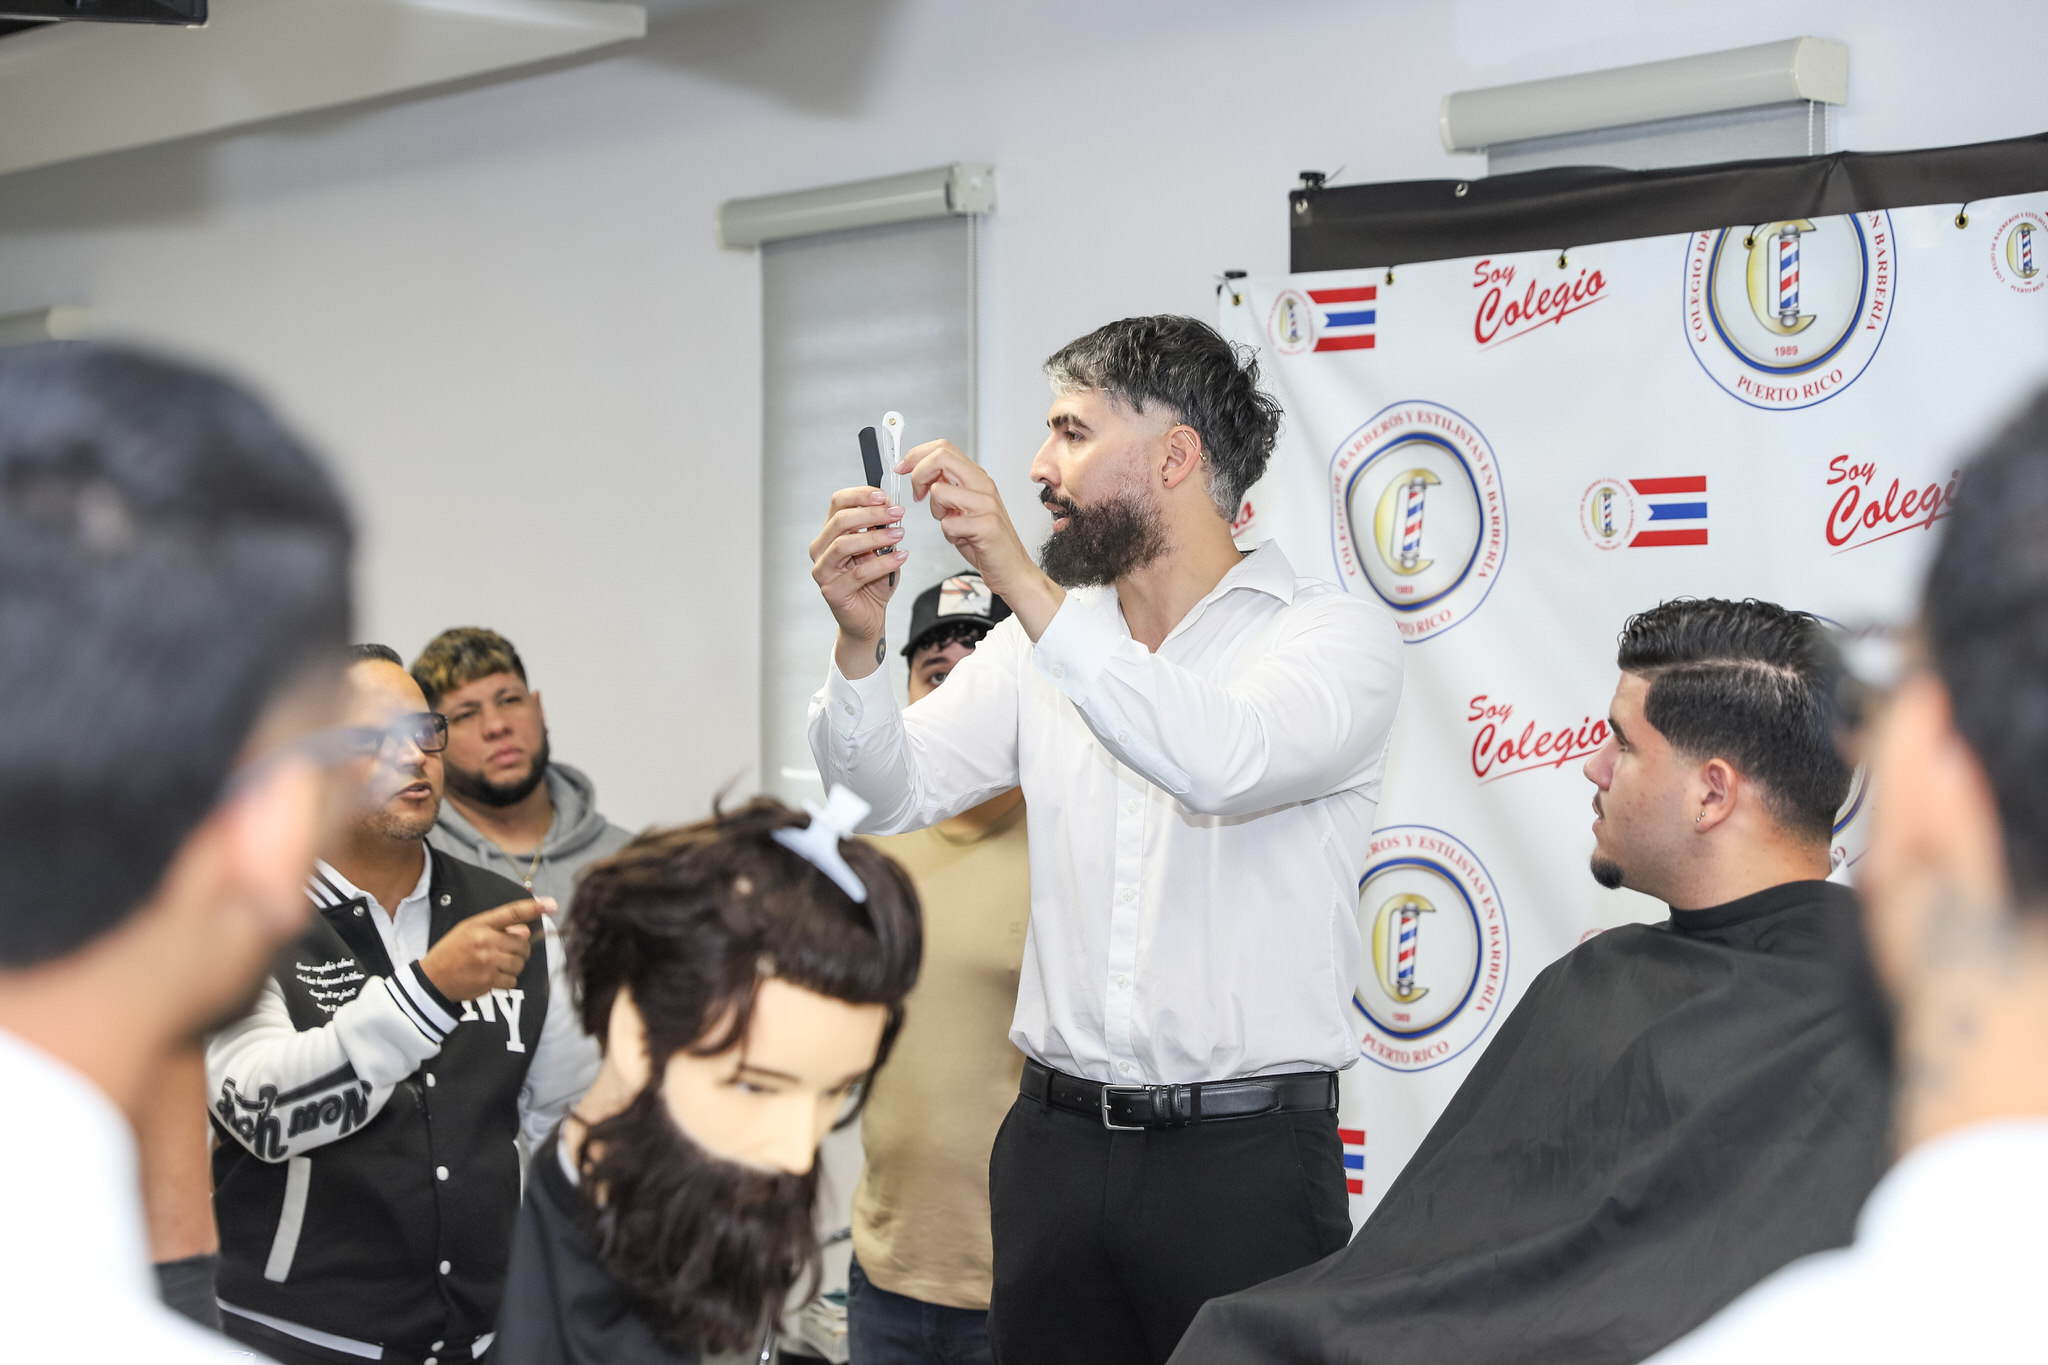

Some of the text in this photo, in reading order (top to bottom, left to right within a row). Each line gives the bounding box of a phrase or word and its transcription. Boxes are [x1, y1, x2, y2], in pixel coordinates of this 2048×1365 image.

[1473, 259, 1517, 288] Soy
[1866, 233, 1888, 330] BARBERÍA
[1474, 268, 1608, 345] Colegio
[1690, 258, 1707, 342] COLEGIO
[1774, 345, 1798, 356] 1989
[1737, 368, 1843, 402] PUERTO RICO
[1338, 411, 1403, 470] BARBEROS
[1404, 410, 1414, 423] Y
[1417, 410, 1486, 462] ESTILISTAS
[1826, 454, 1878, 486] Soy
[1825, 468, 1961, 547] Colegi
[1417, 609, 1452, 636] RICO
[1467, 695, 1514, 724] Soy
[1472, 716, 1611, 778] Colegio
[1405, 835, 1415, 847] Y
[1418, 836, 1487, 895] ESTILISTAS
[1482, 897, 1497, 919] EN
[1362, 1033, 1449, 1064] PUERTO RICO
